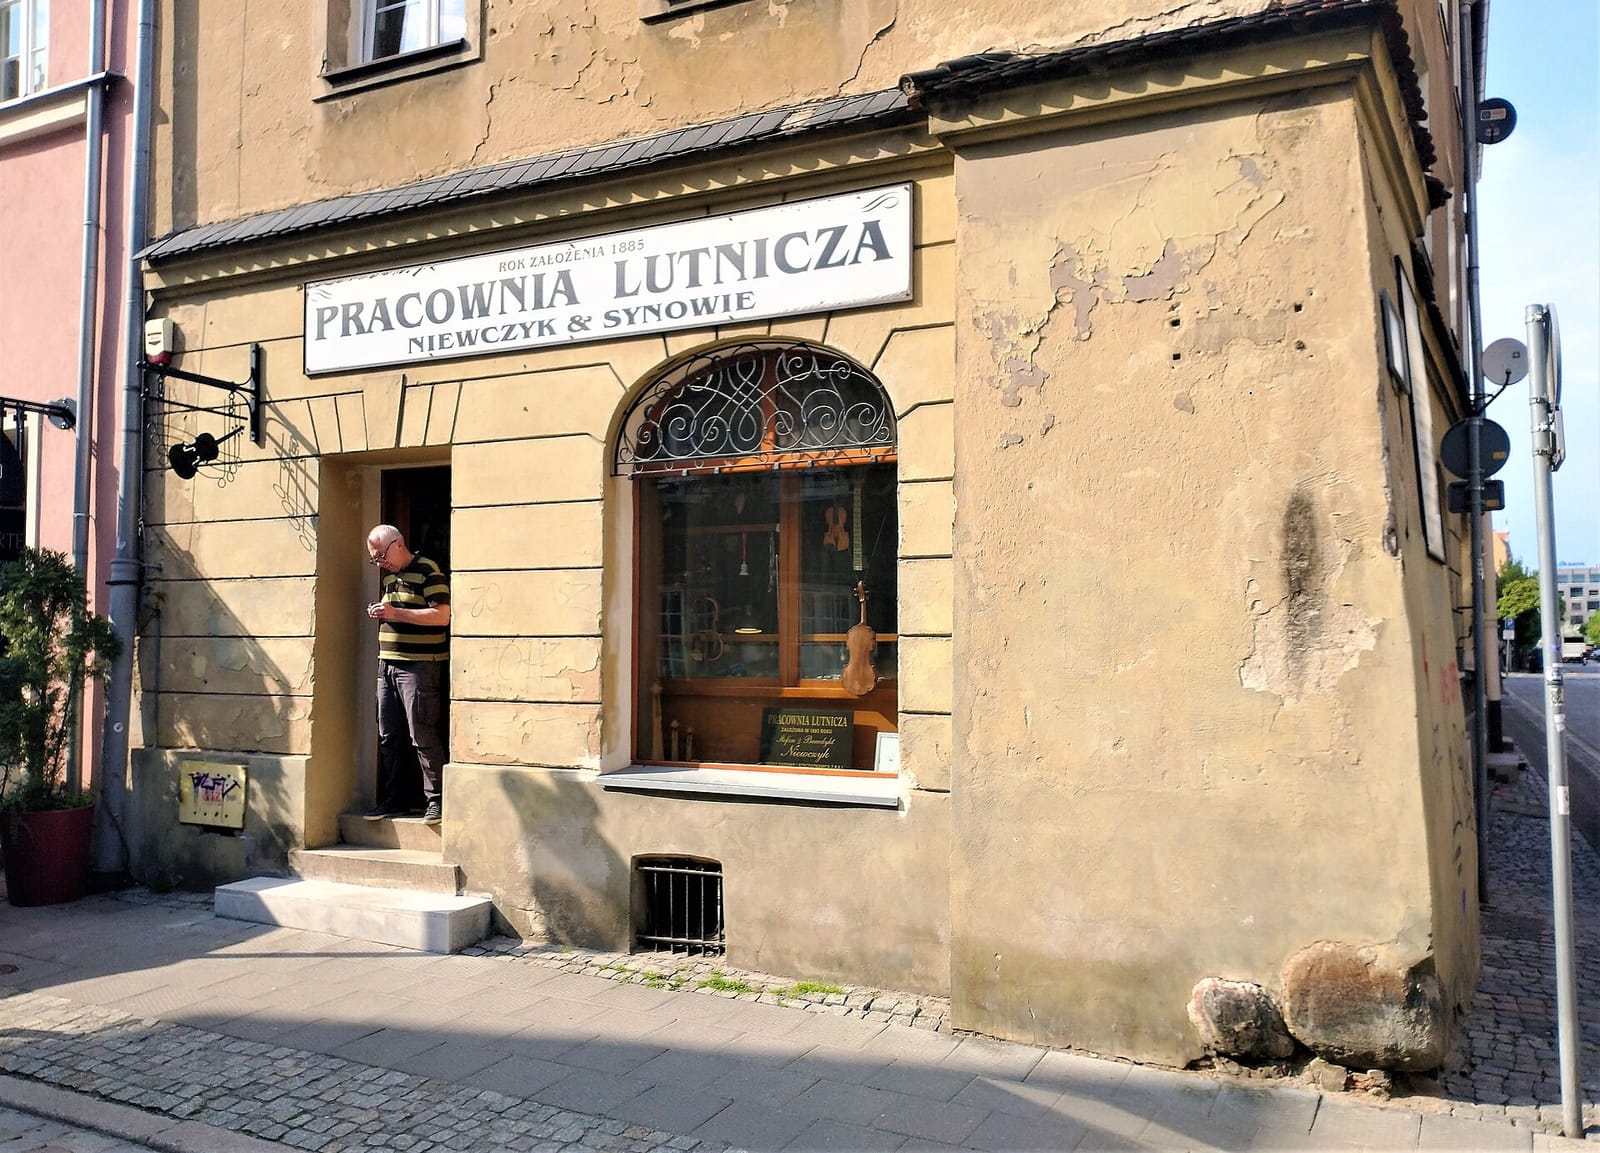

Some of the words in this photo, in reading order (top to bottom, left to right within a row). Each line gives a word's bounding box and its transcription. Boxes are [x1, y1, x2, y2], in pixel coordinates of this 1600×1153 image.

[315, 269, 580, 341] PRACOWNIA
[614, 219, 893, 299] LUTNICZA
[499, 258, 526, 273] ROK
[530, 246, 605, 268] ZAŁOŻENIA
[612, 239, 645, 255] 1885
[408, 318, 557, 354] NIEWCZYK
[567, 314, 592, 333] &
[603, 290, 756, 329] SYNOWIE
[767, 713, 810, 726] PRACOWNIA
[812, 716, 848, 727] LUTNICZA
